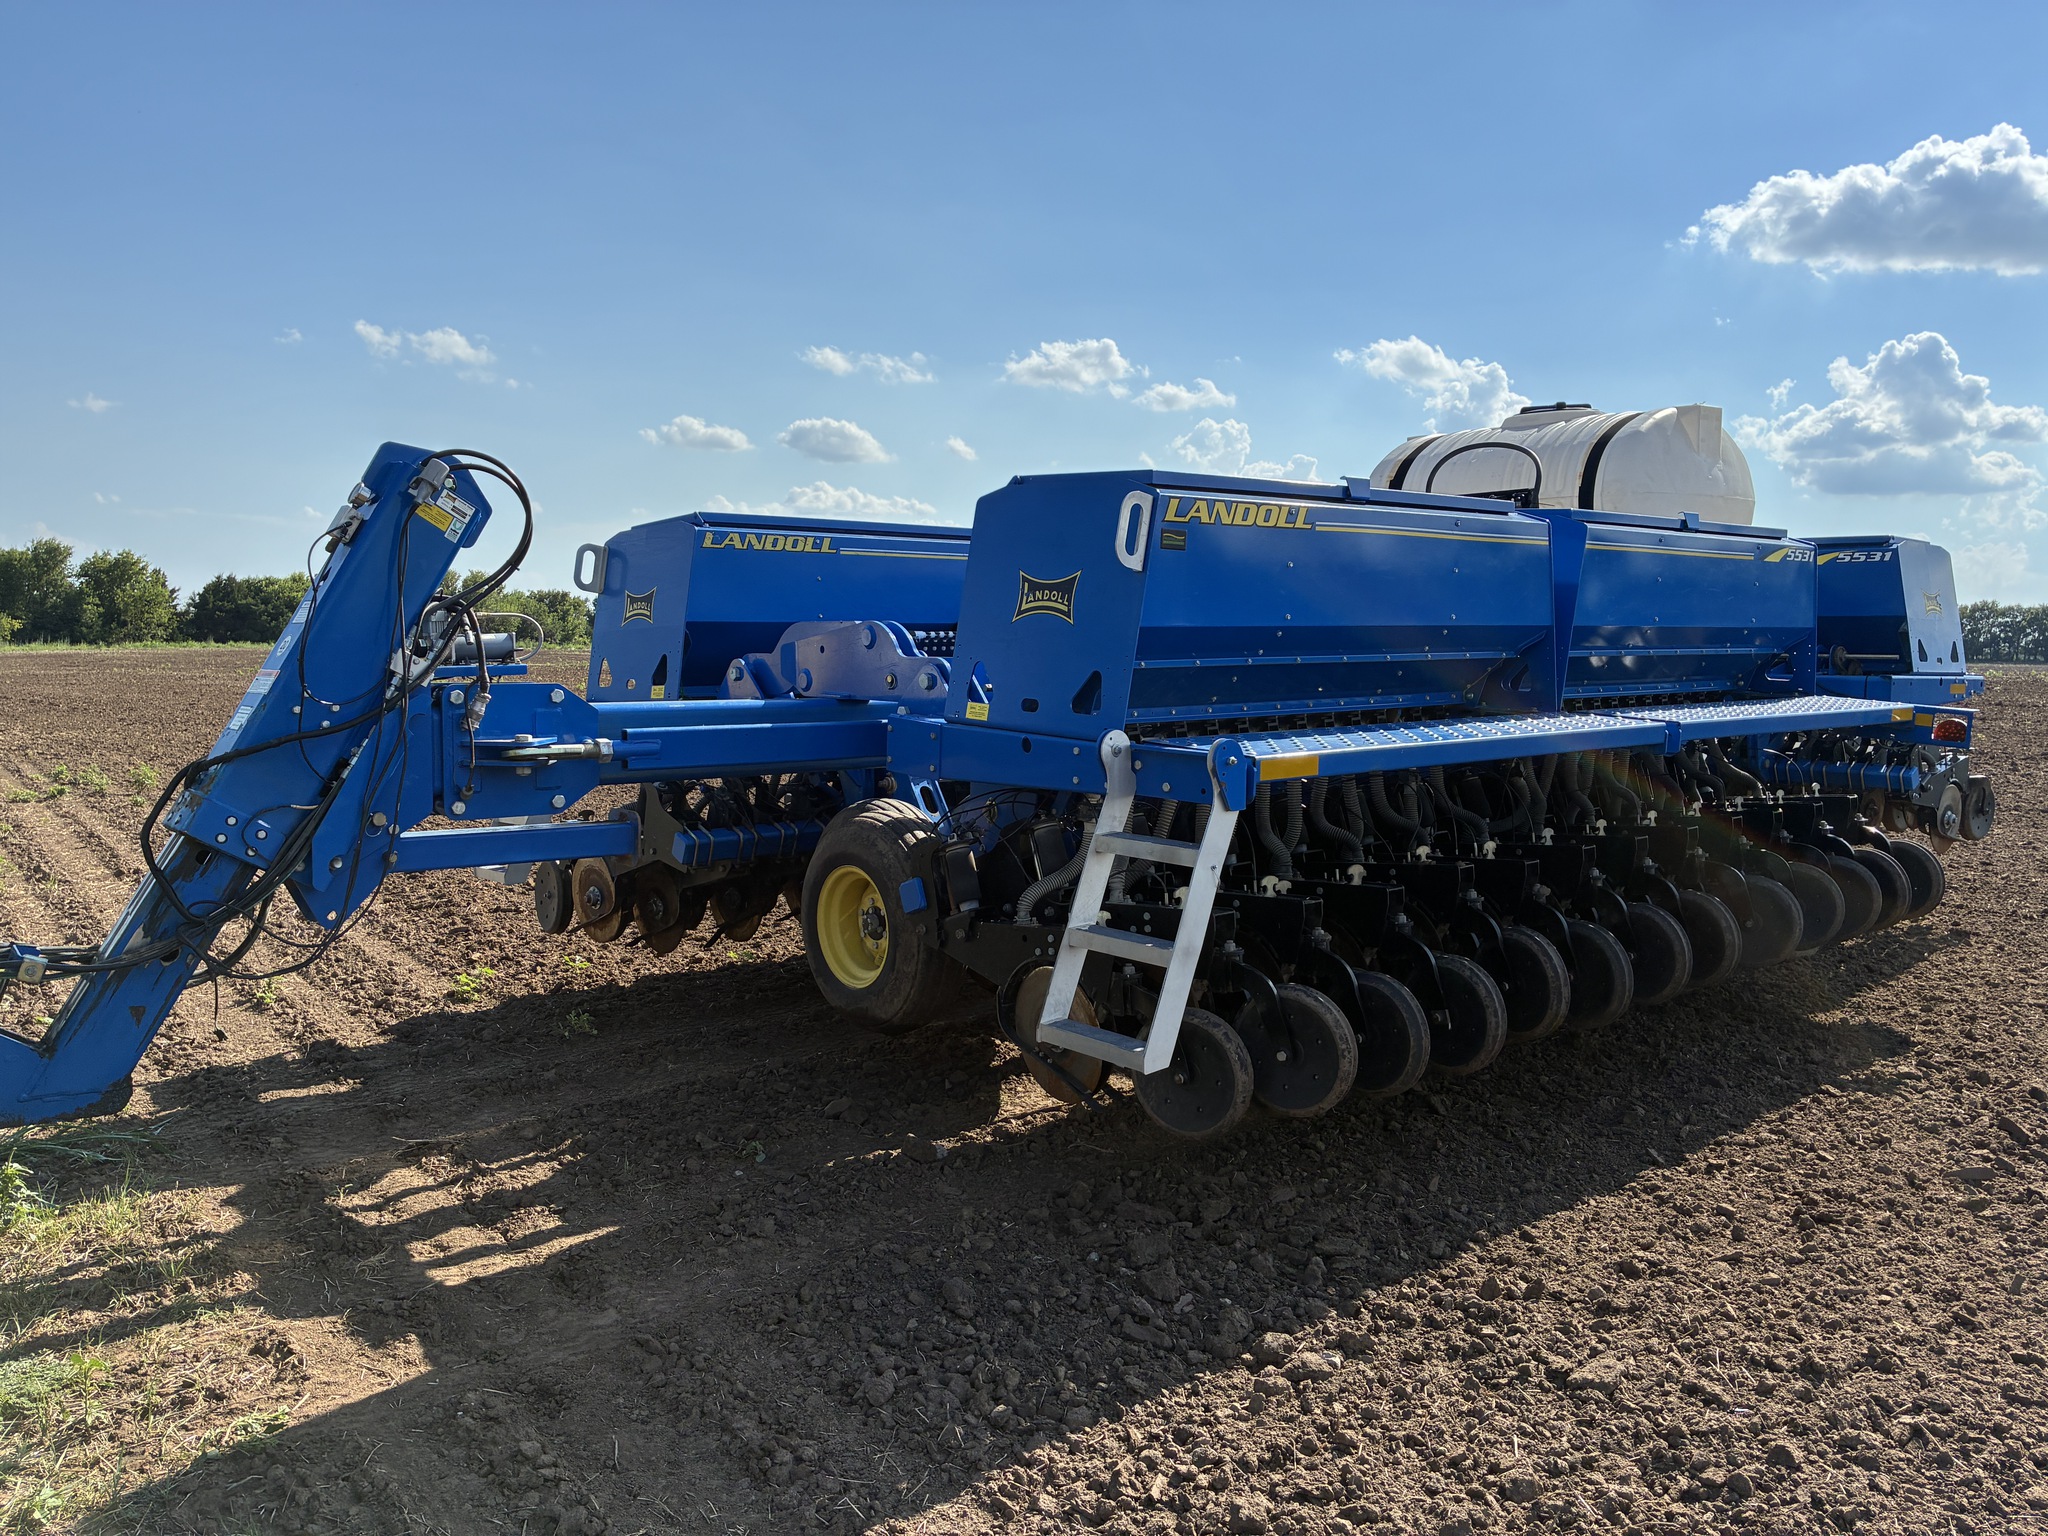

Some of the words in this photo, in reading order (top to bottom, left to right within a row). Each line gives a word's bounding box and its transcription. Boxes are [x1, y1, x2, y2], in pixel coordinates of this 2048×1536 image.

[1164, 498, 1312, 529] LANDOLL
[702, 531, 837, 553] LANDOLL
[1786, 549, 1815, 562] 5531
[1836, 551, 1892, 562] 5531
[1021, 582, 1068, 611] LANDOLL
[626, 598, 651, 618] LANDOLL
